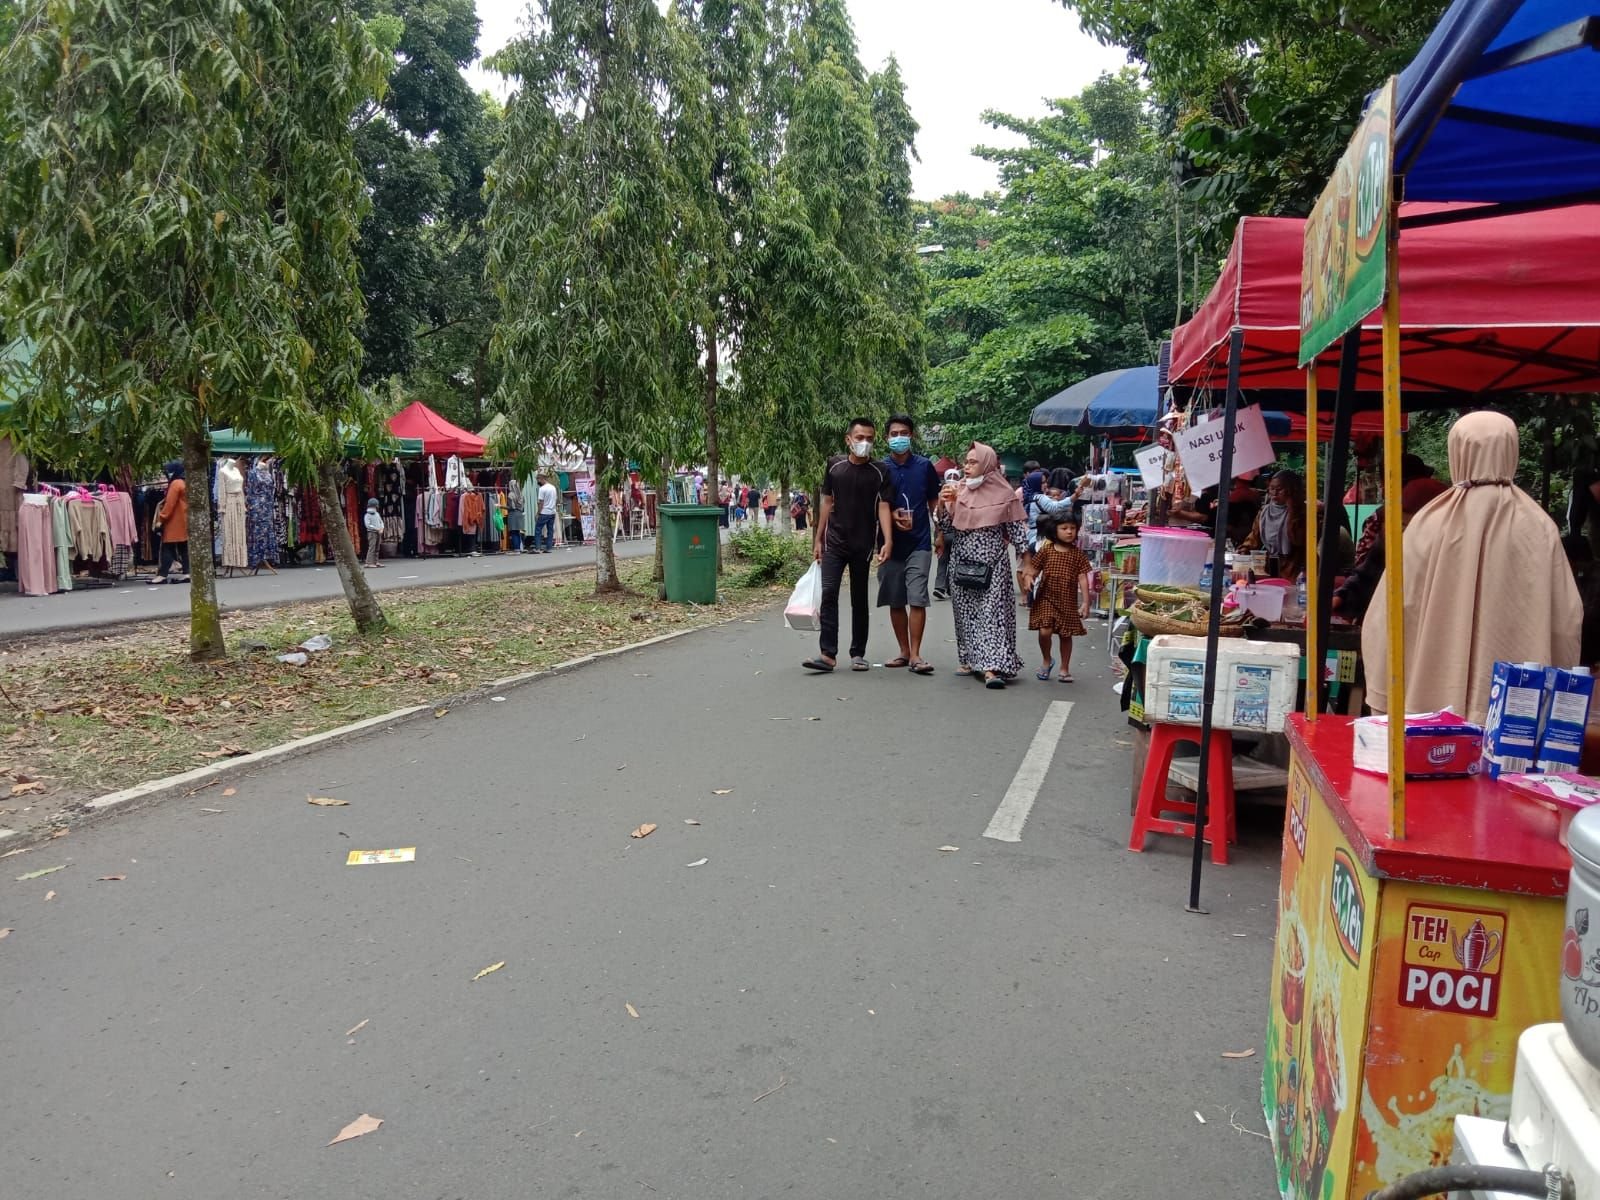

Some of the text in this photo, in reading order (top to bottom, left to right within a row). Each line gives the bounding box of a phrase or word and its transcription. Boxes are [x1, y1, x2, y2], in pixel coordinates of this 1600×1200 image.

[1189, 421, 1246, 450] NASI UUK
[1208, 445, 1237, 462] 8.00
[1290, 807, 1306, 858] POCI
[1343, 874, 1361, 954] Teh
[1411, 914, 1449, 944] TEH
[1418, 945, 1442, 962] Cap
[1406, 968, 1492, 1012] POCI
